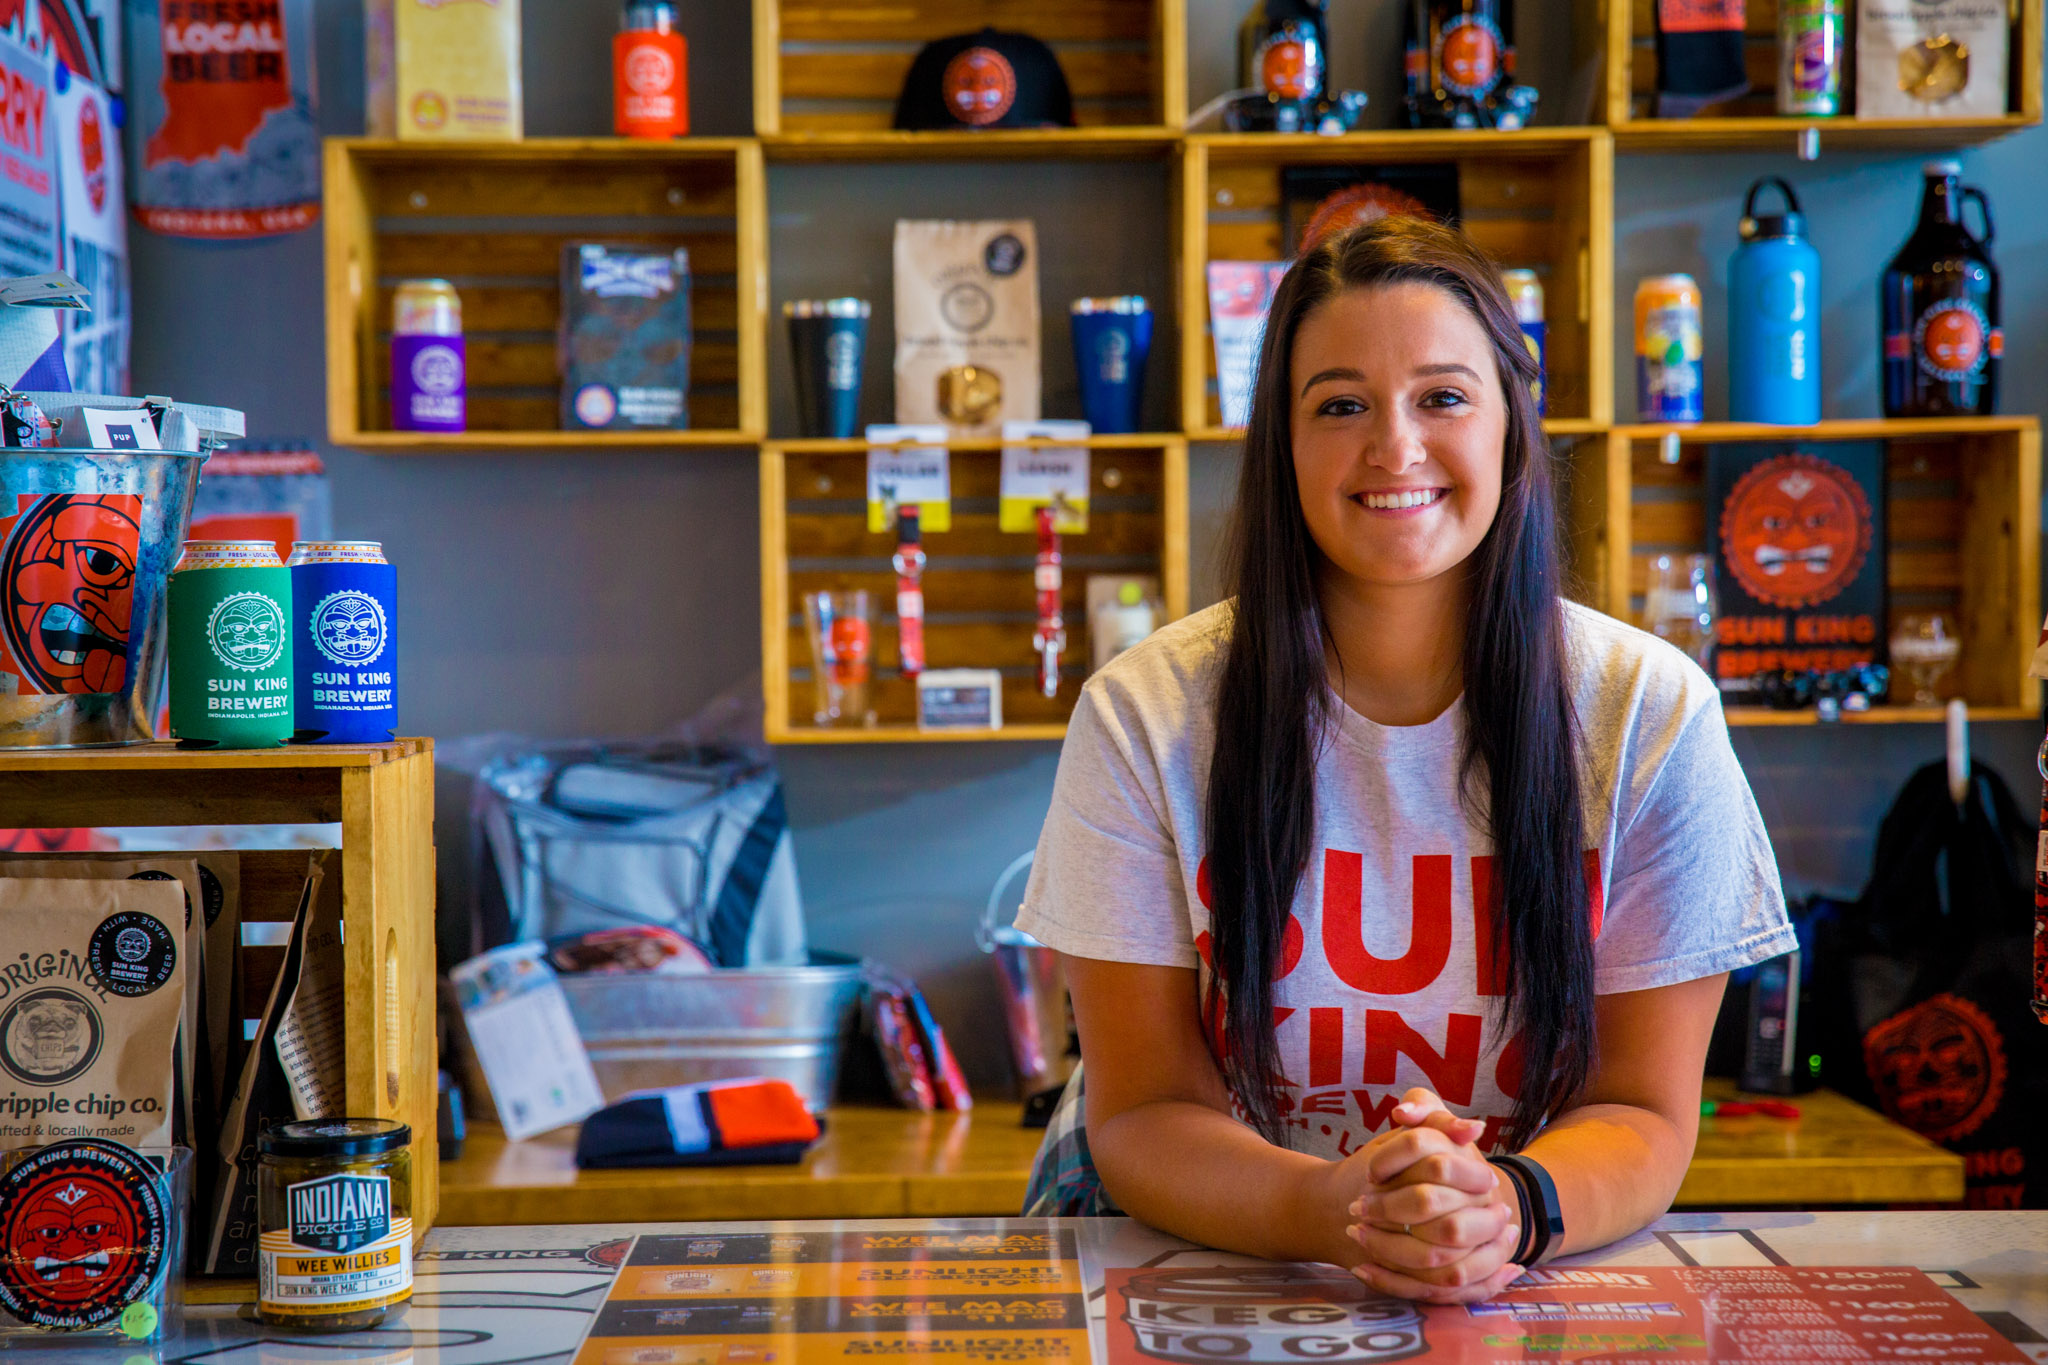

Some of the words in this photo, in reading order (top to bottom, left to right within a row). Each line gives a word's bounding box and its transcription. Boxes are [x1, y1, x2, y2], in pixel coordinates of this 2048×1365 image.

[165, 21, 281, 53] LOCAL
[170, 53, 281, 82] BEER
[113, 433, 131, 441] PUP
[1717, 616, 1786, 645] SUN
[1795, 615, 1876, 643] KING
[207, 678, 246, 692] SUN
[254, 677, 288, 691] KING
[312, 672, 350, 685] SUN
[357, 672, 391, 685] KING
[207, 695, 288, 710] BREWERY
[313, 689, 391, 703] BREWERY
[102, 915, 128, 932] WITH
[141, 916, 168, 939] MADE
[91, 941, 106, 977] FRESH
[110, 969, 148, 980] BREWERY
[111, 961, 128, 970] SUN
[129, 963, 149, 973] KING
[156, 954, 173, 980] BEER
[111, 981, 149, 994] LOCAL
[40, 1042, 62, 1052] CHIPS
[74, 1092, 125, 1120] chip
[130, 1097, 163, 1113] co.
[34, 1125, 45, 1136] &
[49, 1124, 94, 1136] locally
[96, 1124, 135, 1136] made
[11, 1161, 36, 1183] SUN
[37, 1149, 70, 1168] KING
[73, 1148, 133, 1175] BREWERY
[1966, 1147, 2024, 1179] ING
[137, 1183, 160, 1220] FRESH
[295, 1181, 385, 1224] INDIANA
[296, 1220, 367, 1235] PICKLE
[863, 1236, 949, 1244] WEE
[962, 1234, 1057, 1243] MAC
[145, 1228, 161, 1266] LOCAL
[463, 1250, 570, 1259] KING
[296, 1259, 328, 1273] WEE
[333, 1251, 389, 1271] WILLIES
[665, 1271, 712, 1282] SUNLIGHT
[752, 1269, 793, 1277] SUNLIGHT
[860, 1267, 1061, 1276] SUNLIGHT
[1511, 1269, 1652, 1286] LIGHT
[124, 1272, 148, 1301] BEER
[284, 1285, 298, 1295] SUN
[300, 1285, 318, 1295] KING
[320, 1283, 338, 1295] WEE
[340, 1282, 358, 1293] MAC
[1810, 1283, 1905, 1292] $60.00
[0, 1280, 22, 1310] FRES
[852, 1301, 946, 1311] WEE
[962, 1299, 1064, 1310] MAC
[1829, 1300, 1950, 1310] $160.00
[32, 1311, 87, 1327] INDIANA,
[88, 1307, 114, 1323] USA
[1137, 1301, 1413, 1326] KEGS
[847, 1337, 1069, 1348] SUNLIGHT
[1862, 1331, 1990, 1342] $160.00
[1142, 1331, 1253, 1358] TO
[1281, 1331, 1407, 1358] GO
